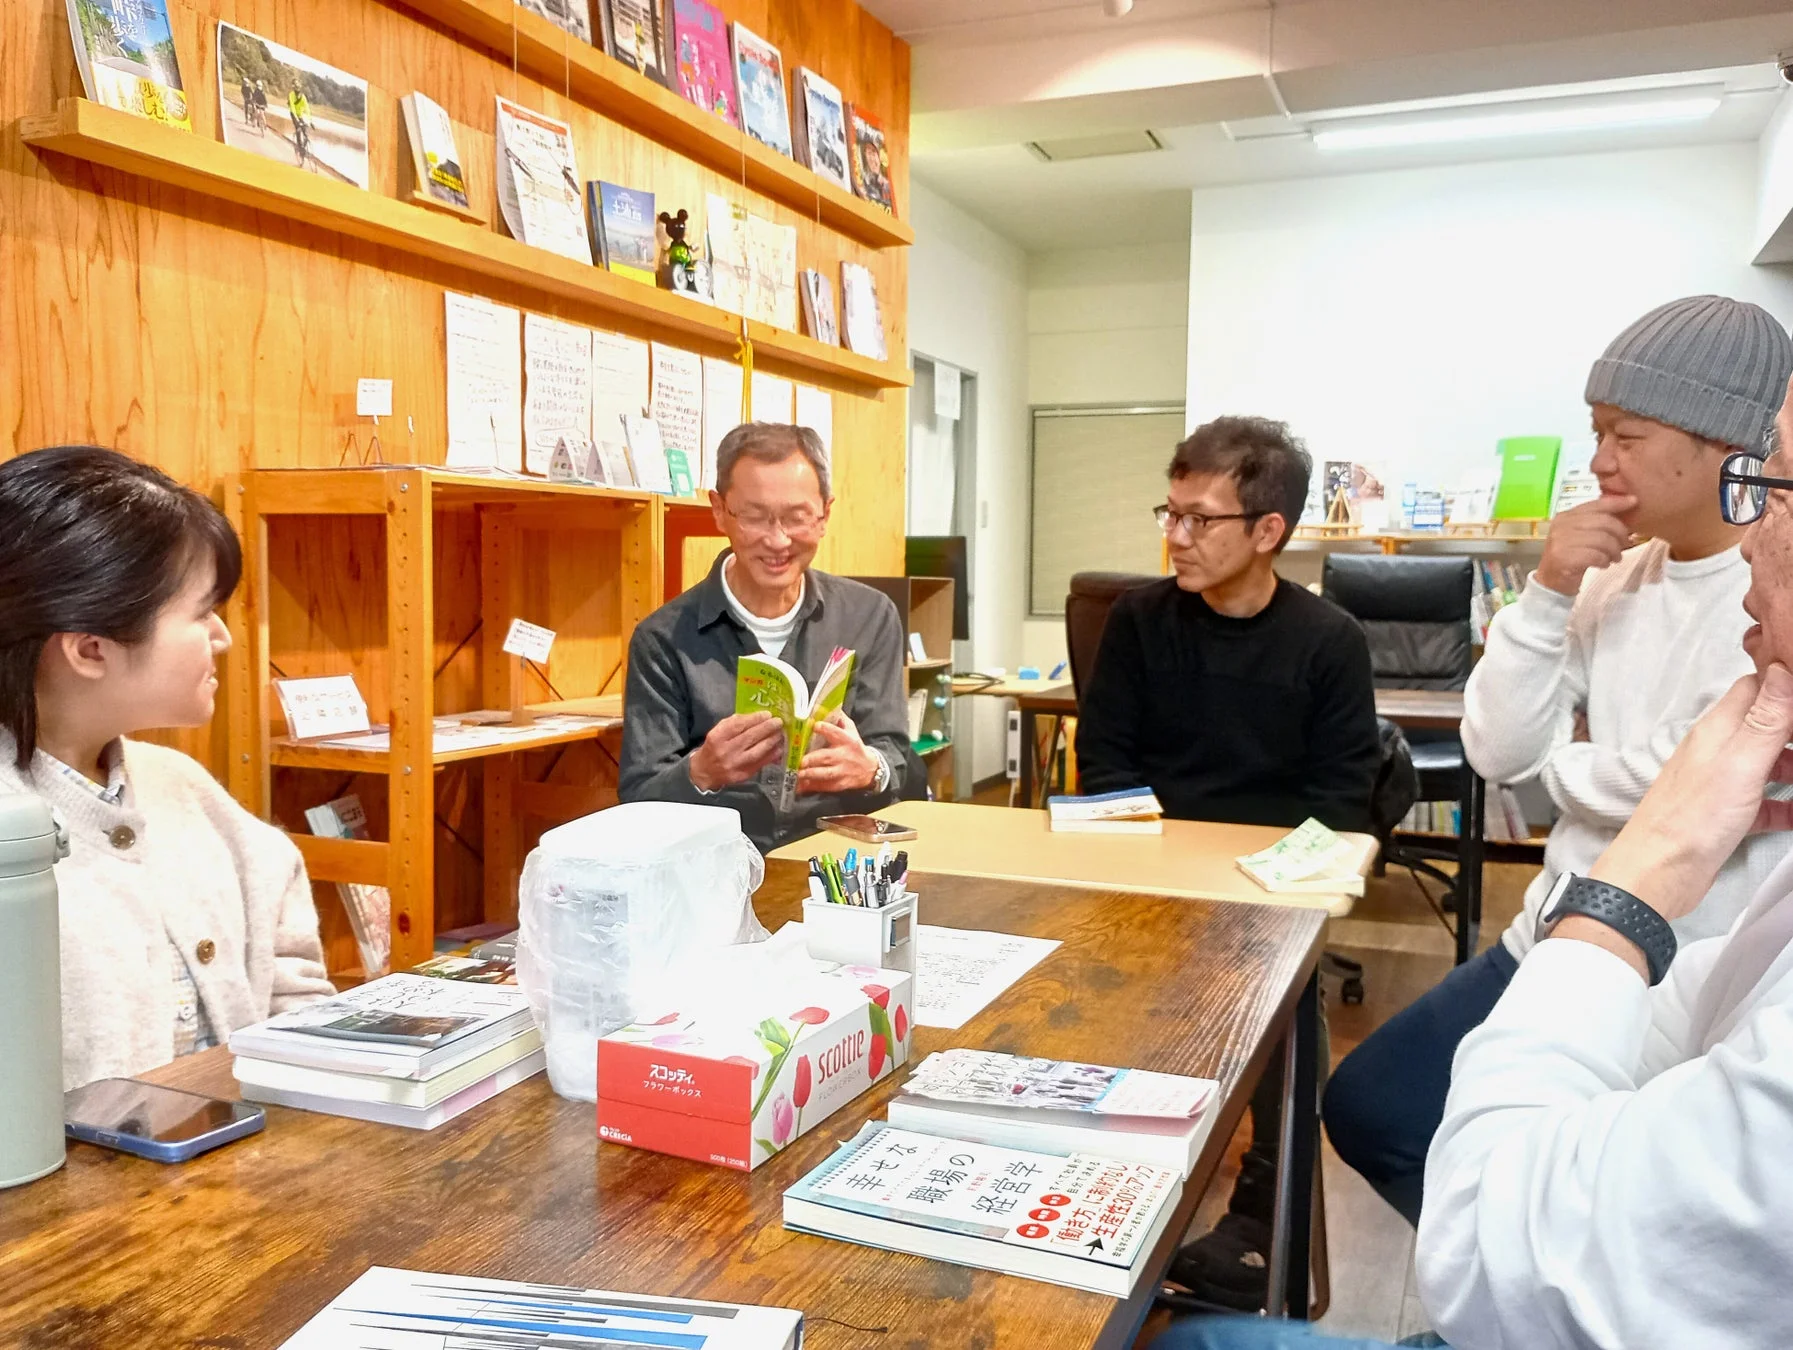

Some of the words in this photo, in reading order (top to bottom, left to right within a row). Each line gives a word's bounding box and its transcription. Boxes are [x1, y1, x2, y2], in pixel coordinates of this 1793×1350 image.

[649, 1064, 694, 1085] スコッティ
[818, 1029, 865, 1085] scottie
[643, 1080, 702, 1098] フラワーボックス
[846, 1143, 918, 1191] 幸せな
[906, 1153, 976, 1204] 職場の
[971, 1161, 1044, 1215] 経営学
